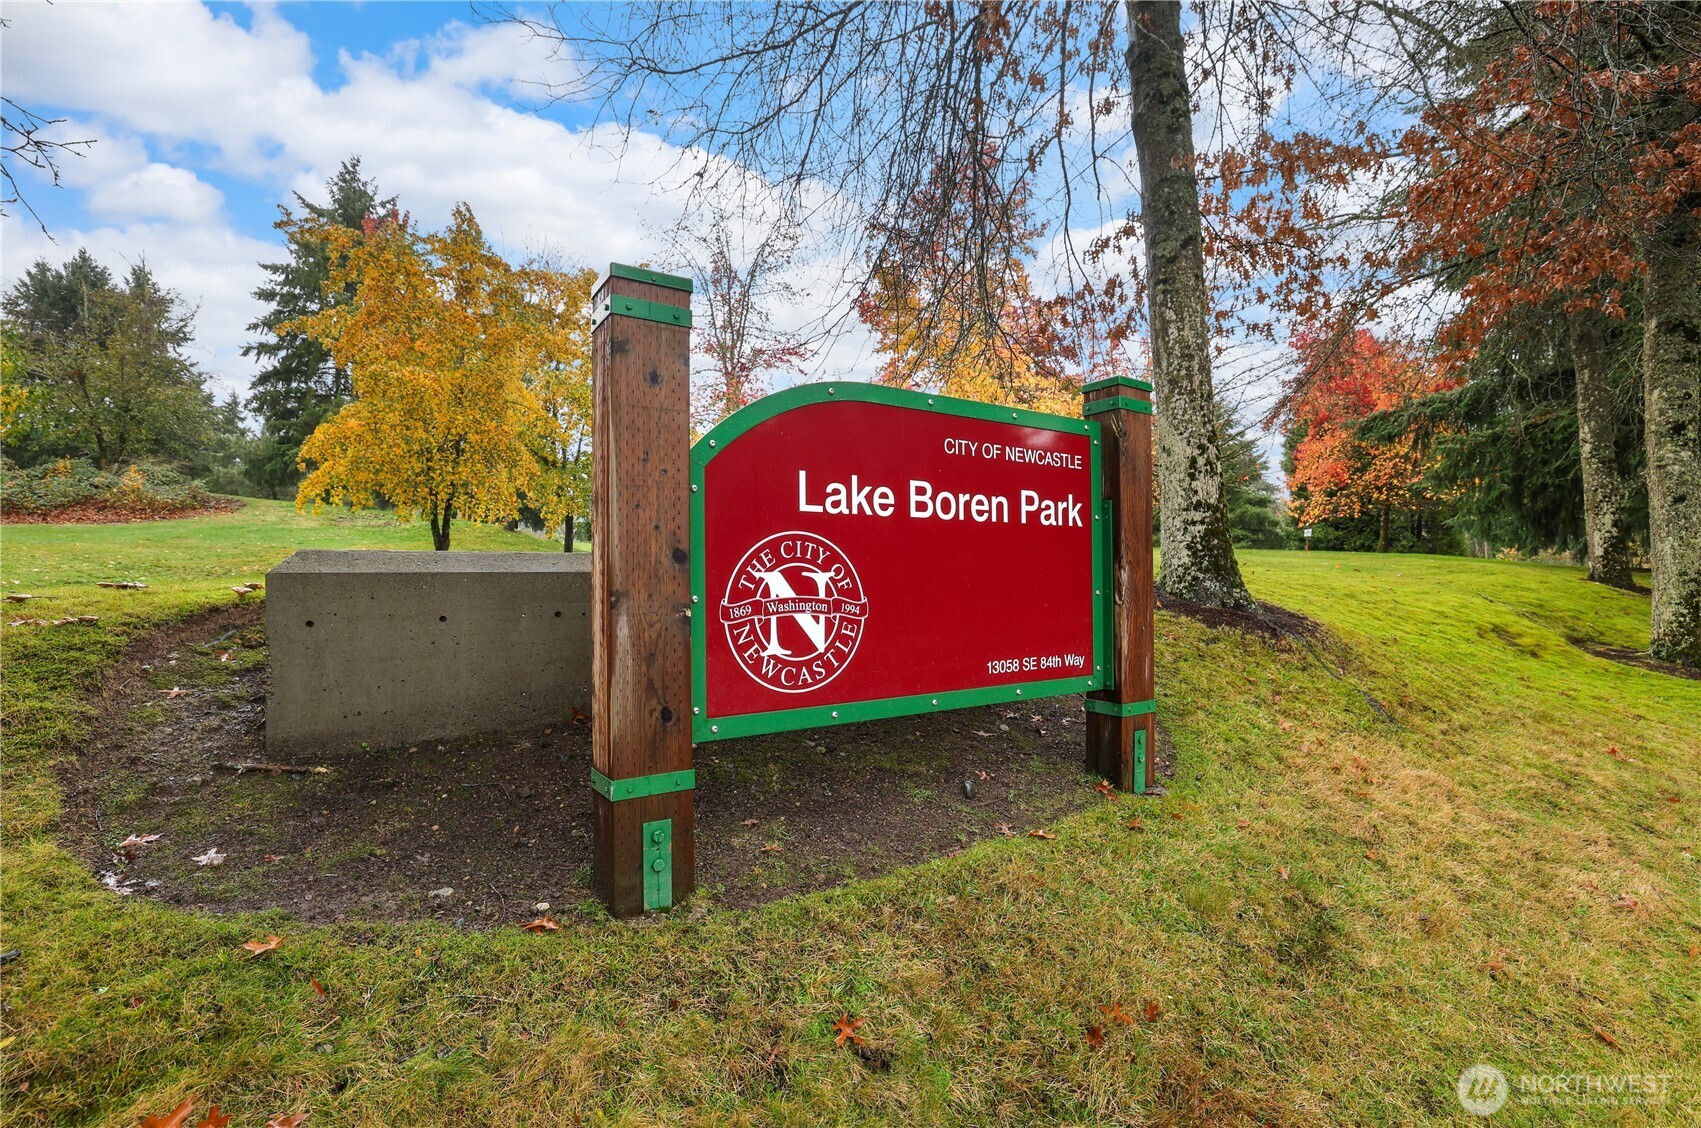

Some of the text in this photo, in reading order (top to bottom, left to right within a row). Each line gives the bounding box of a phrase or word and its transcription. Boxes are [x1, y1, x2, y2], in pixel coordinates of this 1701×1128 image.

[944, 438, 1082, 469] CITY OF NEWCASTLE
[799, 470, 1083, 527] Lake Boren Park
[738, 541, 852, 590] THE CITY OF
[729, 604, 752, 619] 1869
[766, 600, 828, 613] Washington
[841, 603, 860, 615] 1994
[733, 621, 858, 686] NEWCASTLE
[987, 653, 1085, 675] 13058 SE 84th Way
